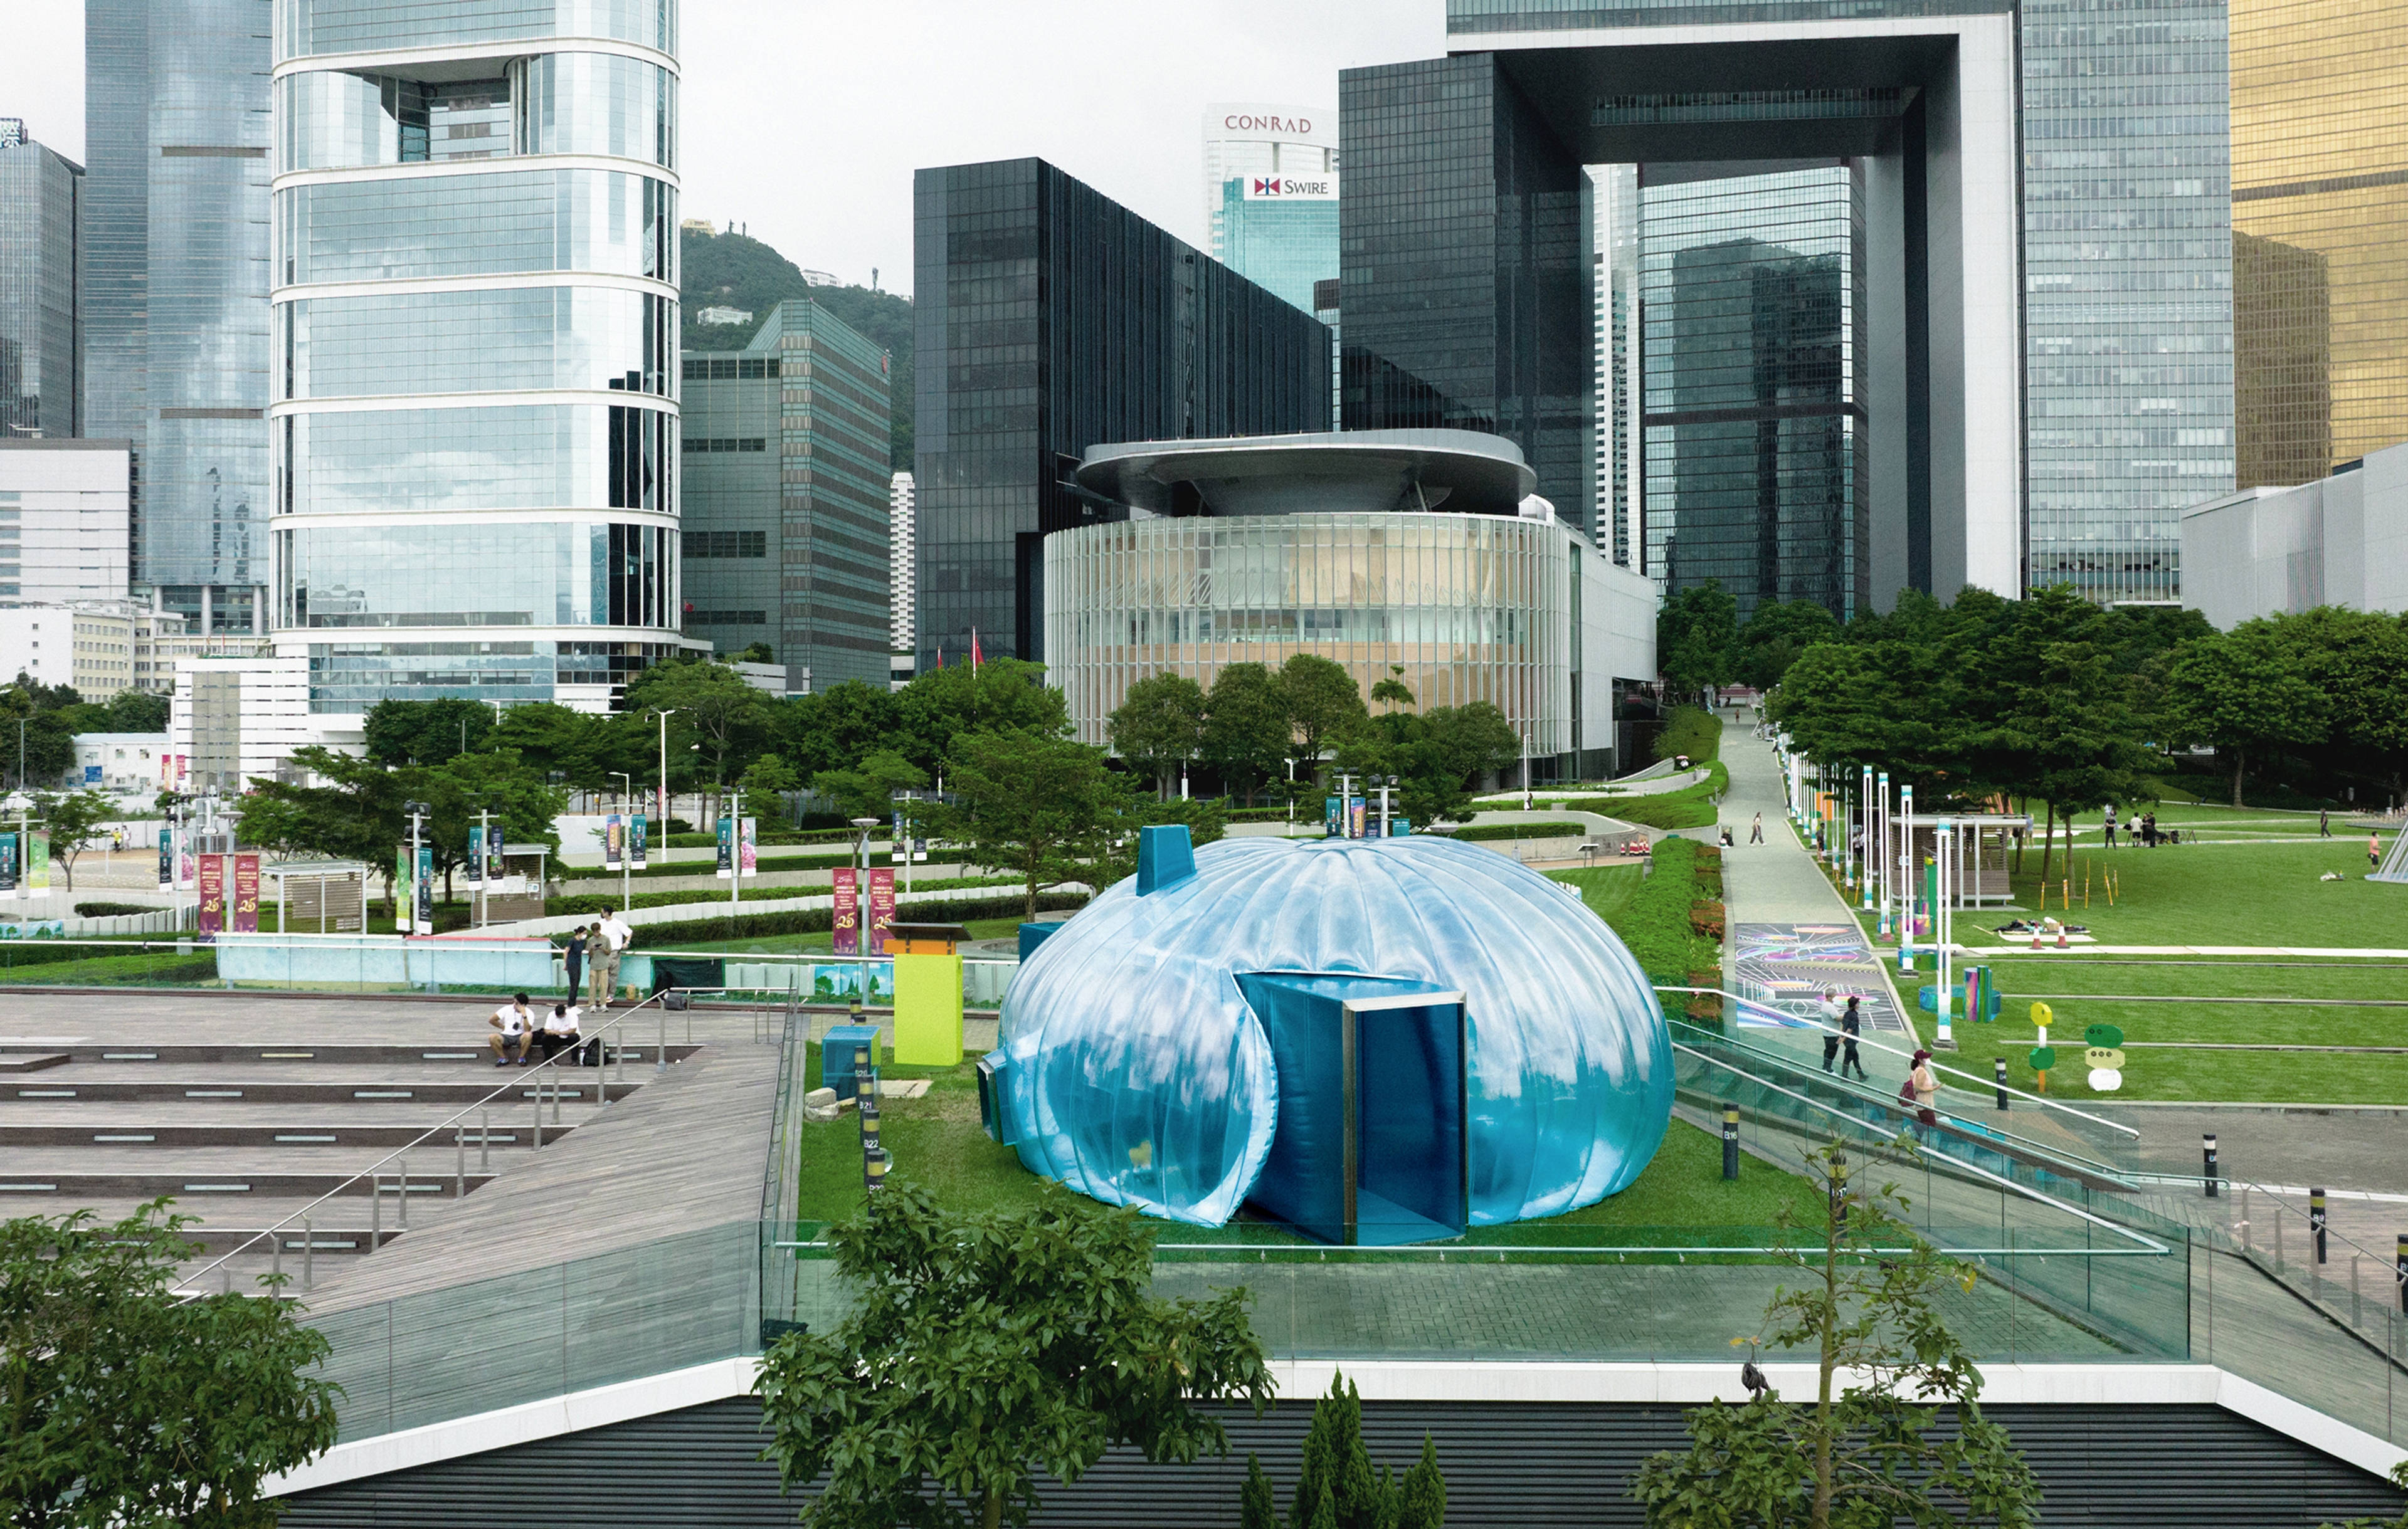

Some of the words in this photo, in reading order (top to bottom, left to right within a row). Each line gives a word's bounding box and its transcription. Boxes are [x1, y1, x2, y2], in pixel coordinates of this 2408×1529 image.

[1225, 115, 1311, 134] CONRAD
[203, 896, 219, 913] 25
[238, 897, 256, 913] 25
[836, 912, 855, 929] 25
[859, 1101, 872, 1110] B21
[1724, 1131, 1738, 1140] B16
[864, 1139, 879, 1148] B22
[2313, 1214, 2325, 1222] B9
